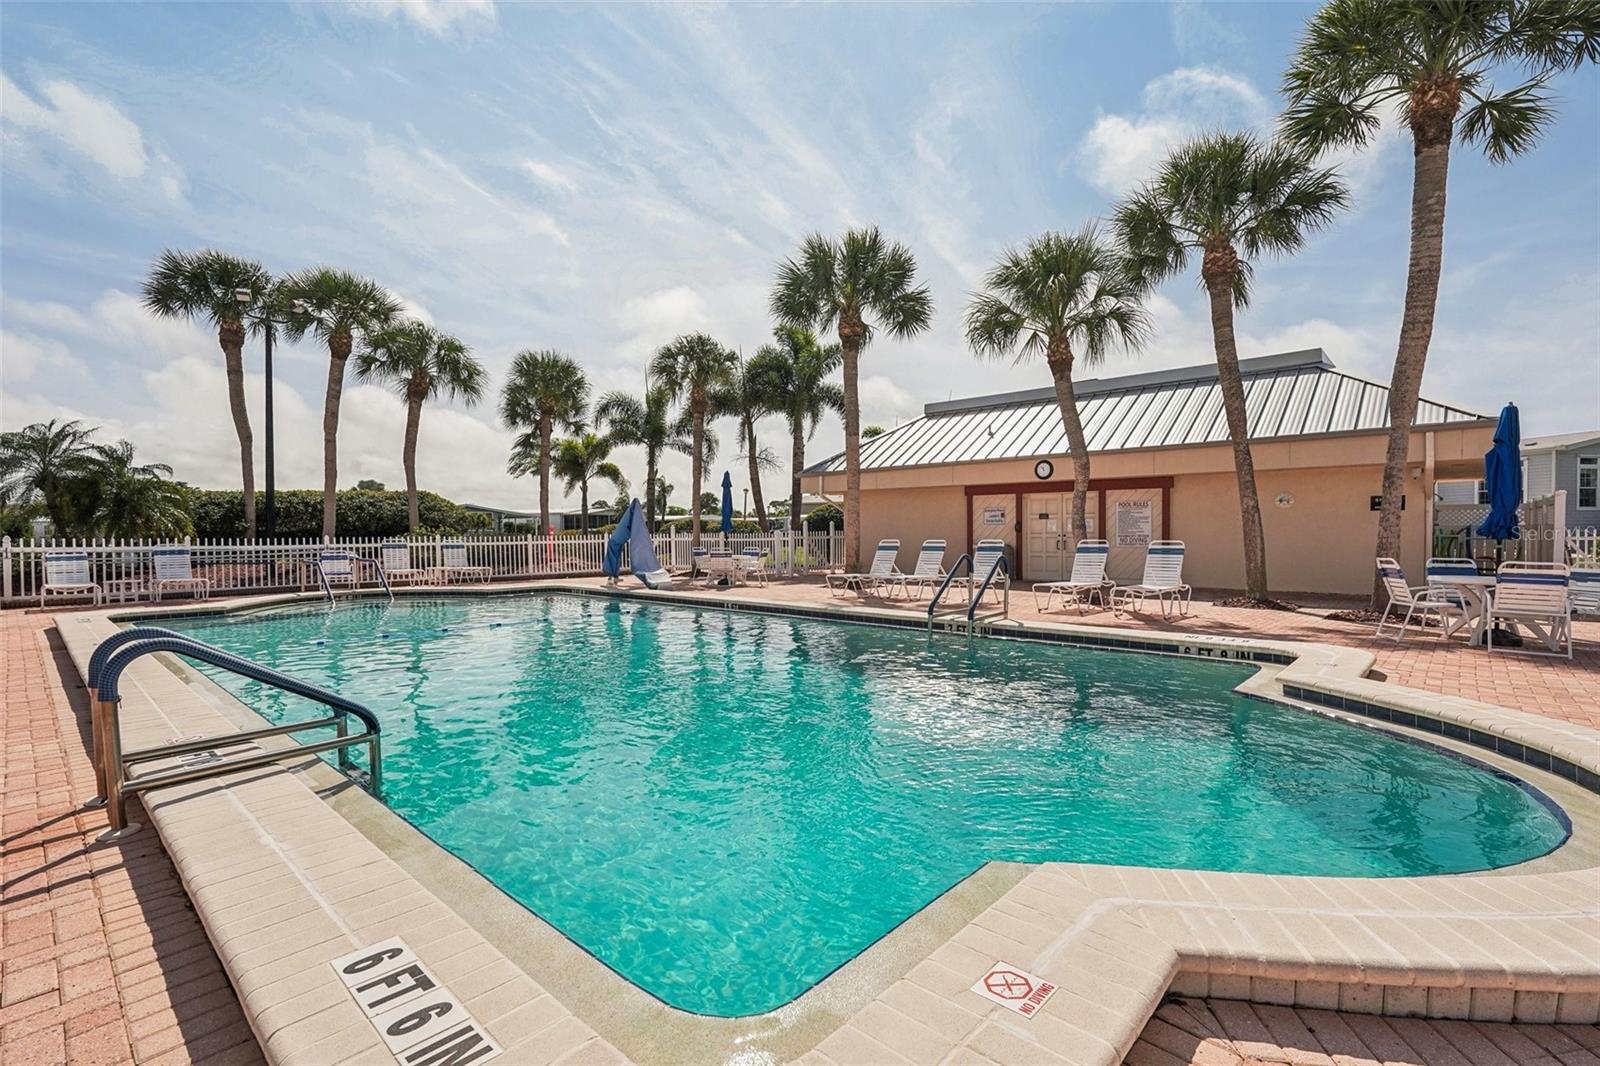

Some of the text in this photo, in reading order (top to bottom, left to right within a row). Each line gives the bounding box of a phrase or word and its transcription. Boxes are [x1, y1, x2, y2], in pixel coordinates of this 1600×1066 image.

[1198, 647, 1213, 657] FT
[342, 947, 494, 1066] 6 FT 6 IN
[1018, 982, 1056, 1016] NO DIVING
